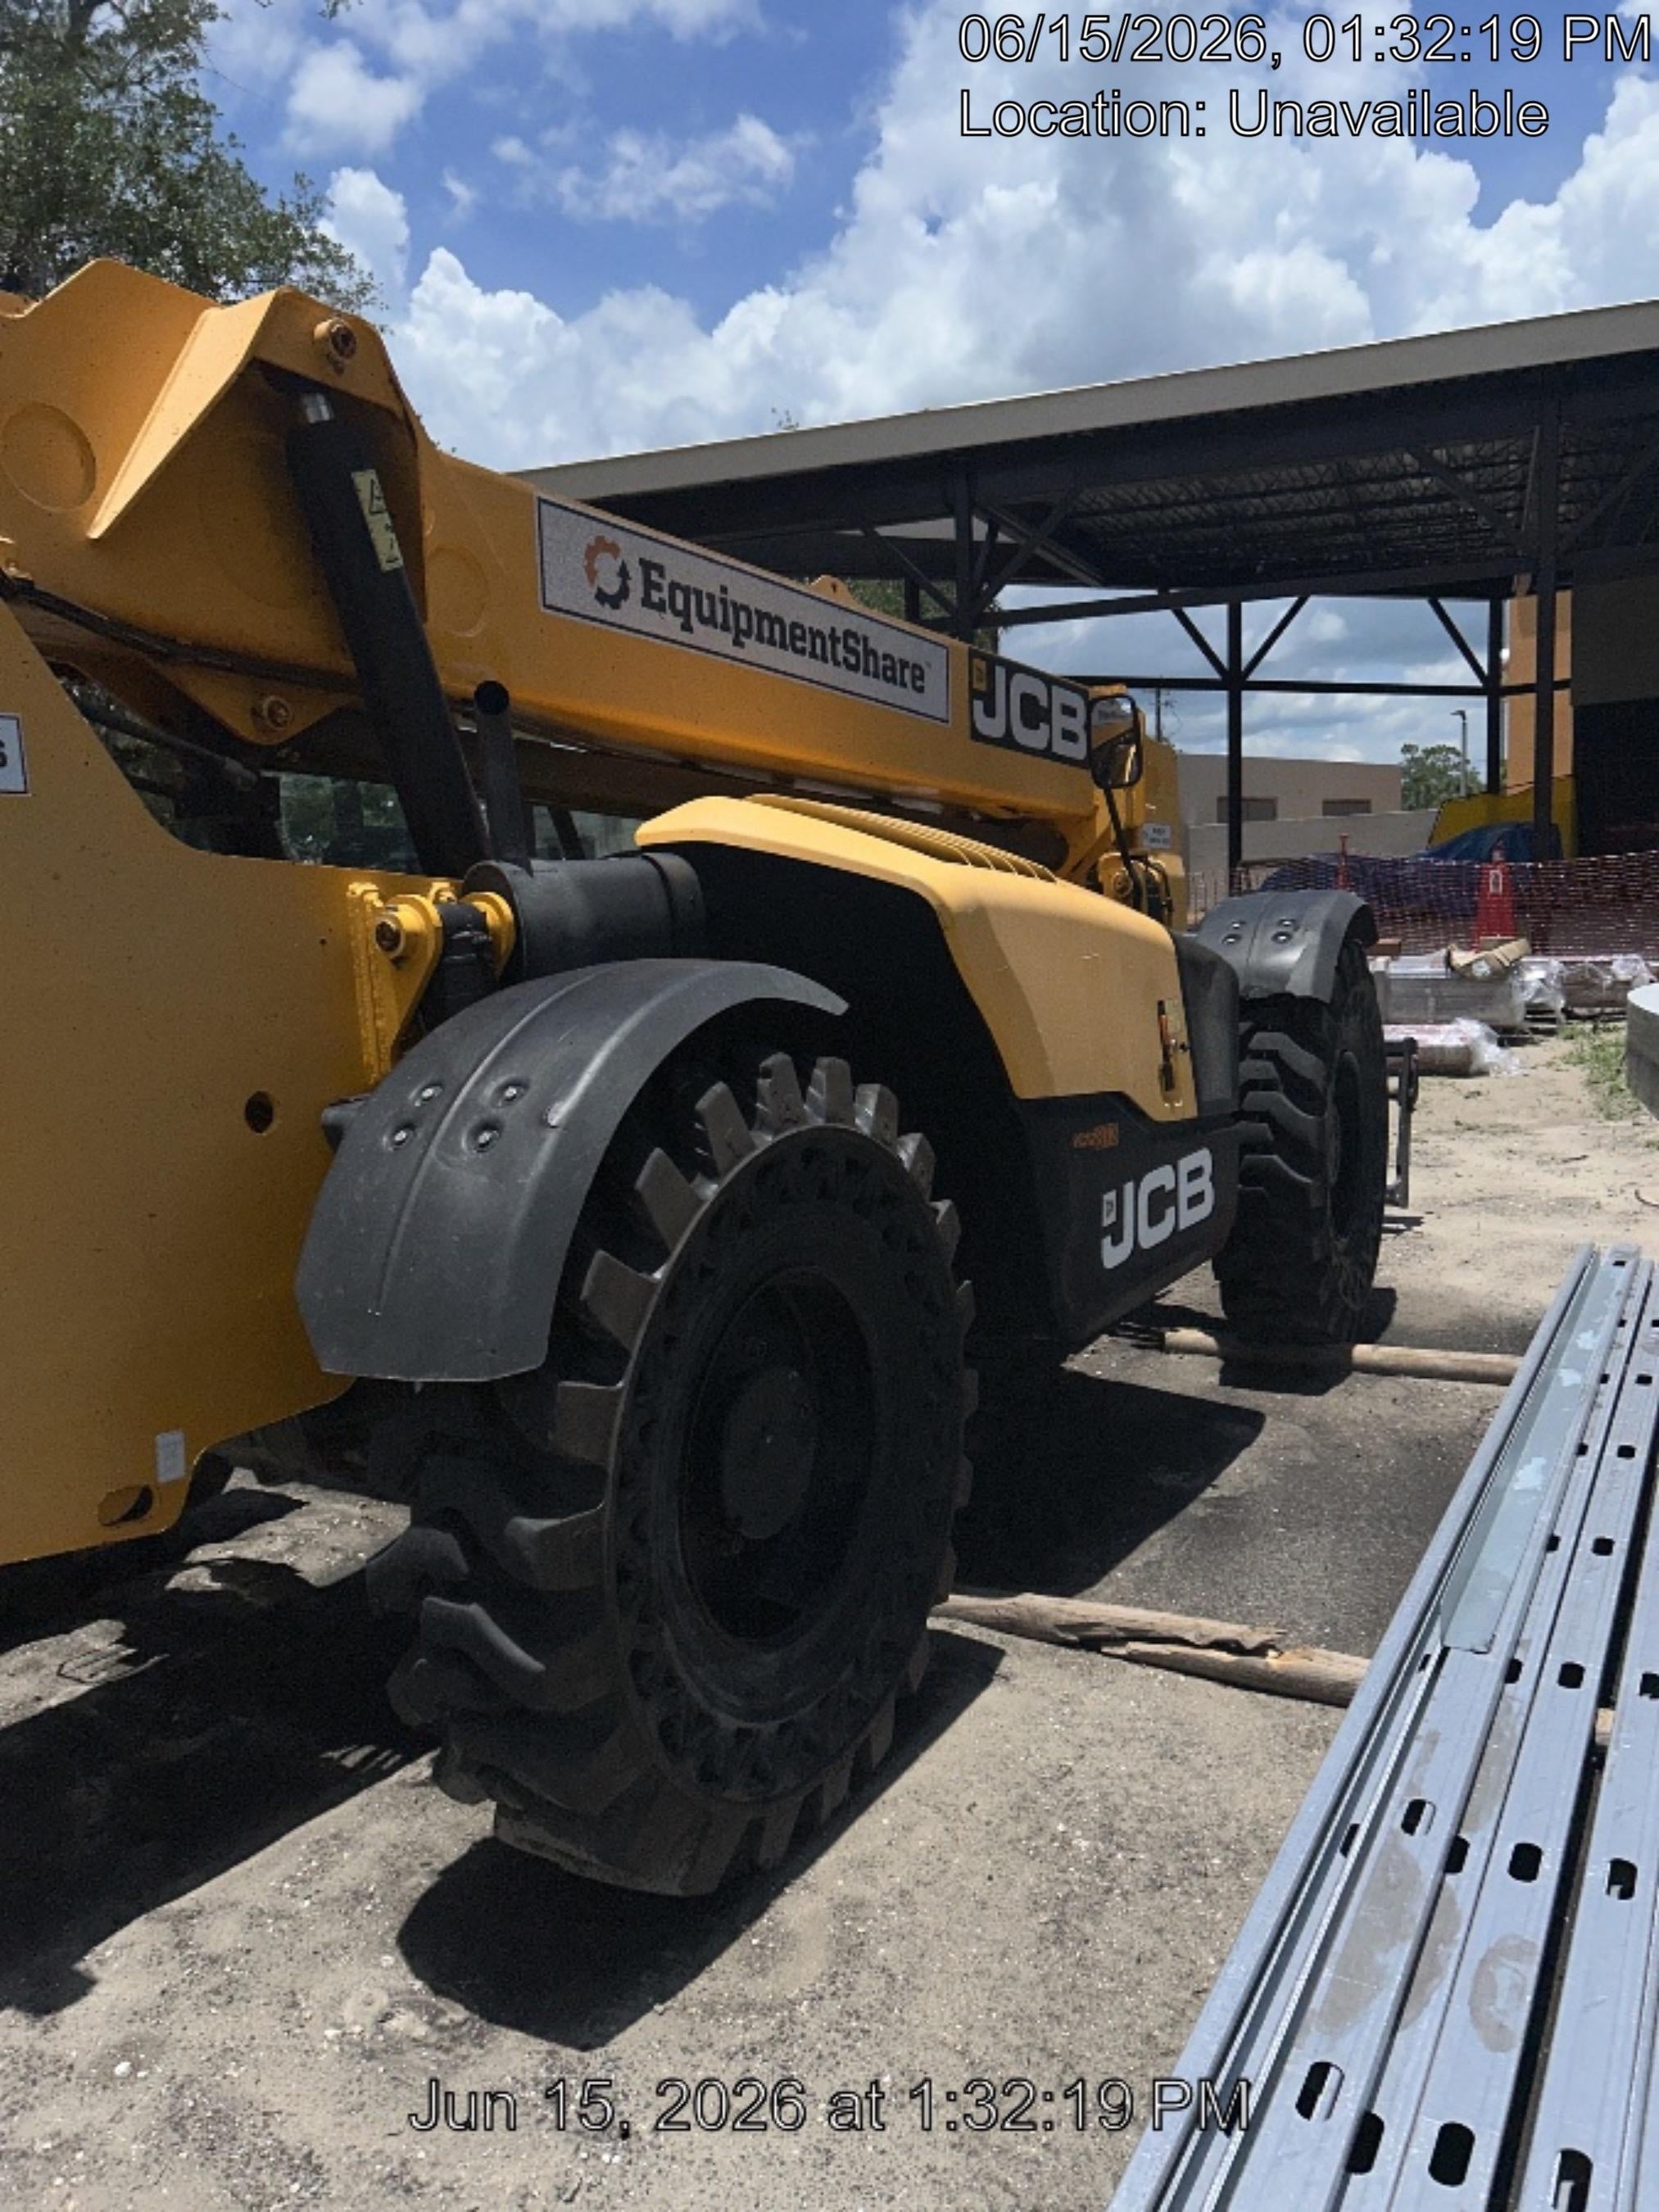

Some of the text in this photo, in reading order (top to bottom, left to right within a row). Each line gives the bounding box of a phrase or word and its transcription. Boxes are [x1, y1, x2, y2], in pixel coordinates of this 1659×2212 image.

[639, 558, 925, 694] EquipmentShare
[972, 664, 1087, 760] JCB
[1100, 1147, 1215, 1269] JCB
